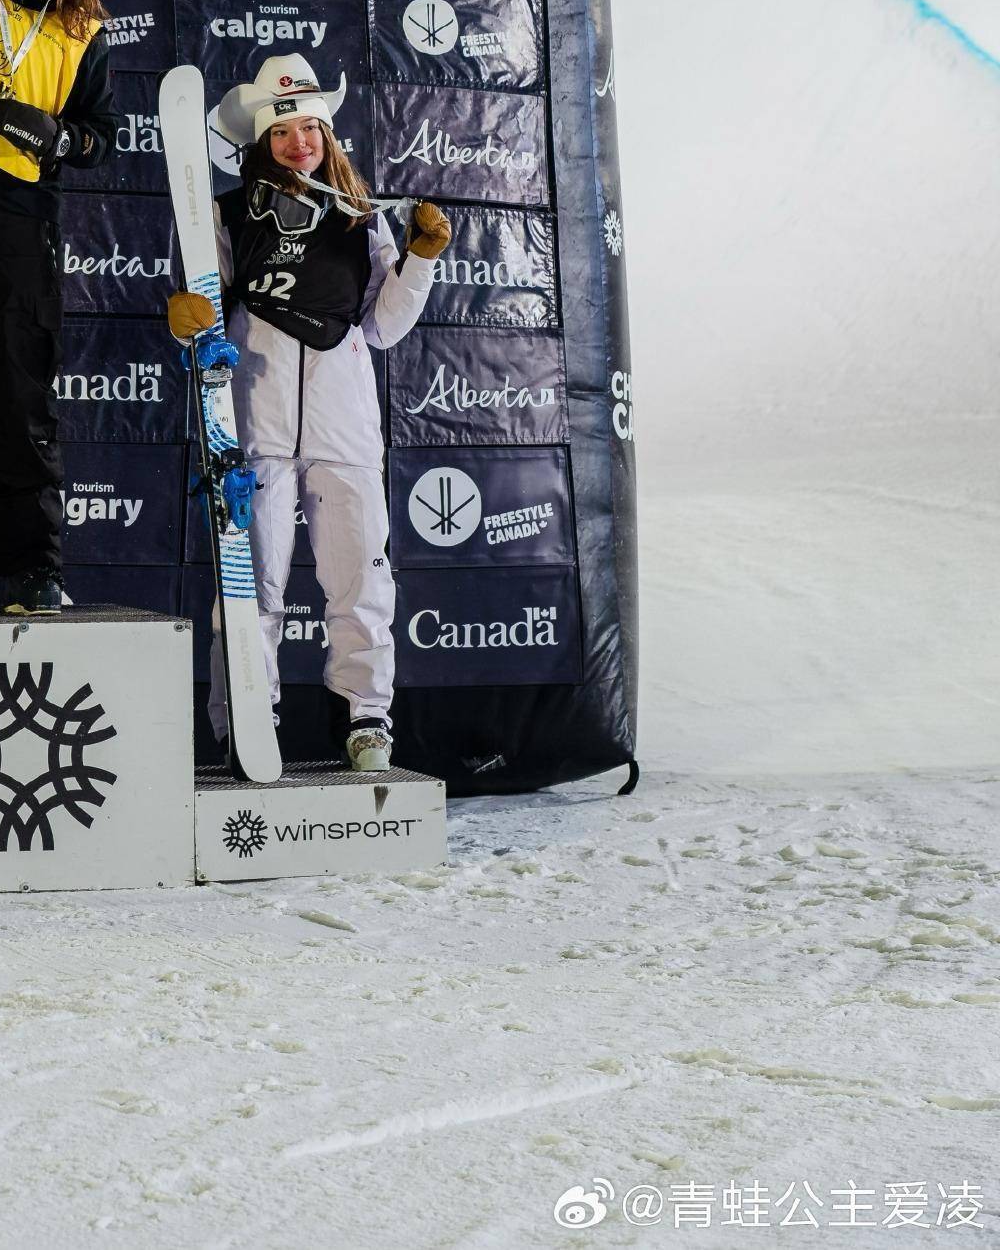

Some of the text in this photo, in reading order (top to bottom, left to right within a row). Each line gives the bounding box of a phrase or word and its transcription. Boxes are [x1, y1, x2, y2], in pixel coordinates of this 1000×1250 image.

[101, 13, 155, 32] ESTYLE
[259, 4, 299, 15] tourism
[211, 11, 328, 48] calgary
[3, 123, 44, 147] ORIGINALS
[388, 118, 518, 168] Alberta
[63, 243, 159, 277] berta
[405, 364, 542, 415] Alberta
[72, 482, 115, 493] tourism
[483, 502, 554, 530] FREESTYLE
[486, 523, 541, 546] CANADA
[373, 557, 384, 568] OR
[408, 606, 559, 649] Canada
